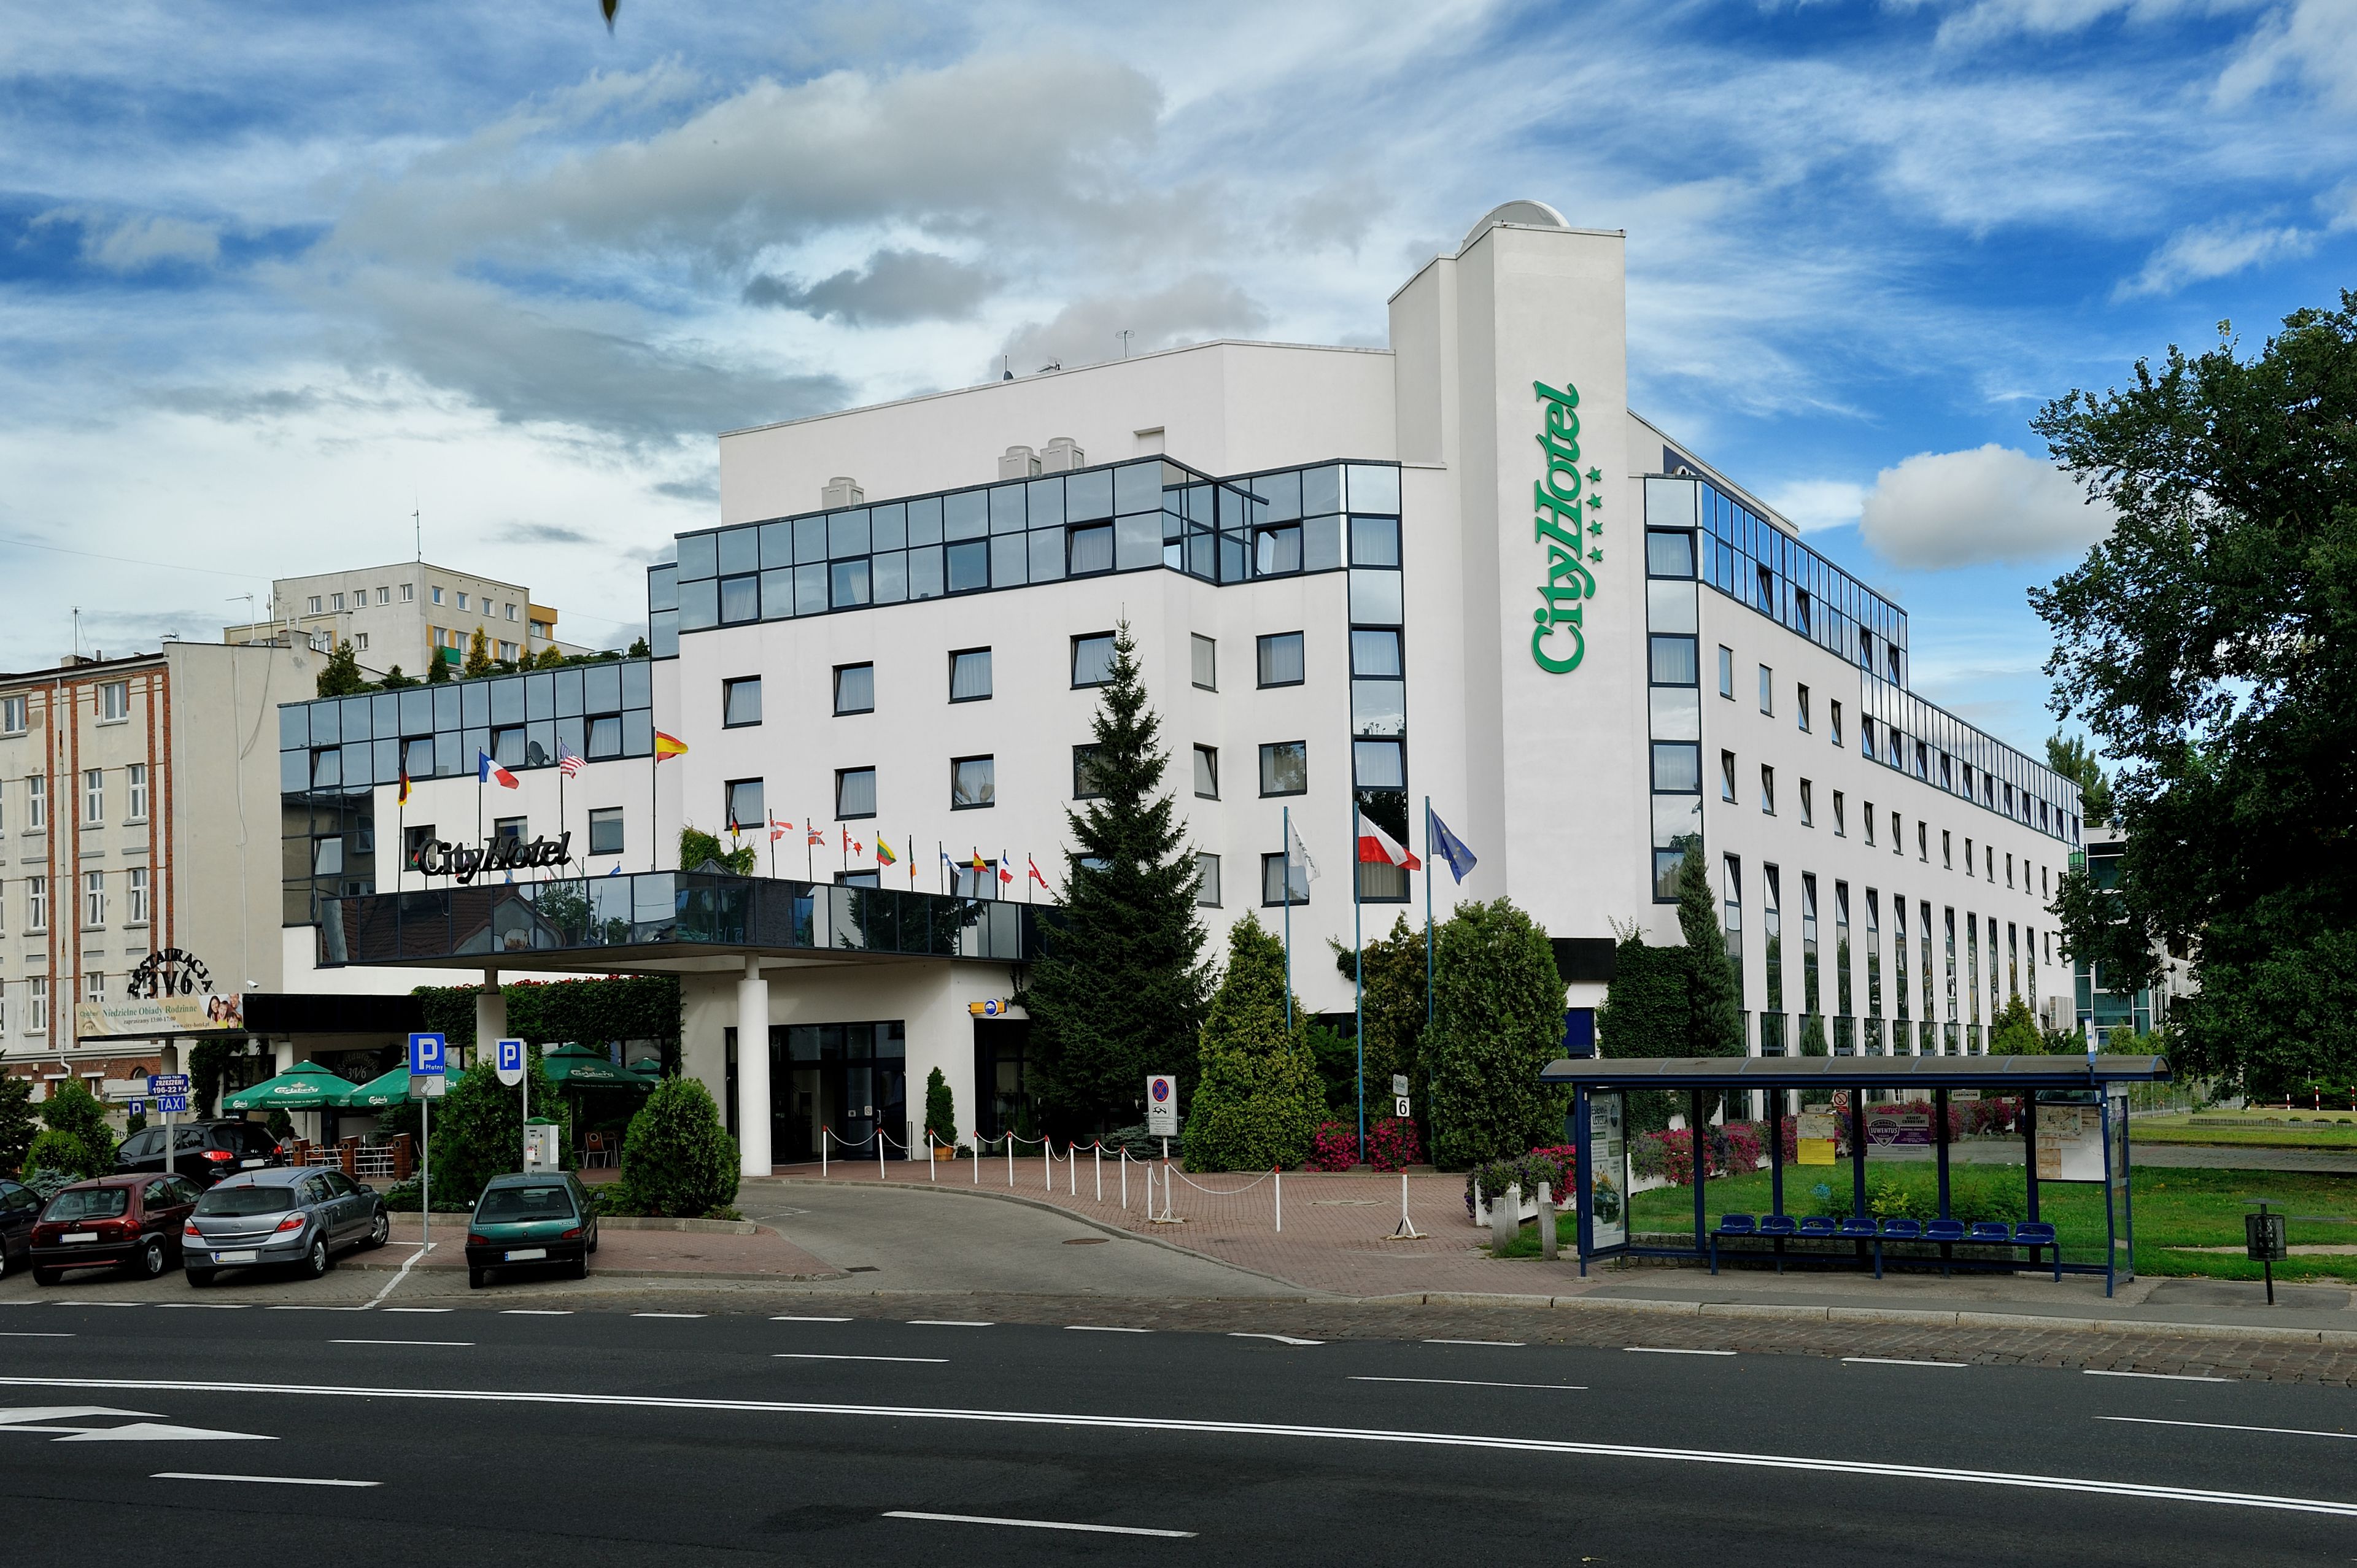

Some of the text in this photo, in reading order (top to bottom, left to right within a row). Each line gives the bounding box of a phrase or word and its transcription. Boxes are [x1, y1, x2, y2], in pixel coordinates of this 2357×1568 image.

[1531, 380, 1596, 674] CityHotel
[418, 831, 571, 884] CityHotel
[147, 968, 193, 997] 3V6
[103, 1004, 197, 1018] Niedzielne Obiady Rodzinne
[418, 1038, 438, 1070] P
[504, 1045, 516, 1067] P
[570, 1070, 614, 1078] Carlsberg
[274, 1086, 320, 1095] Carlsberg
[159, 1097, 184, 1111] TAXI
[1399, 1100, 1407, 1115] 6
